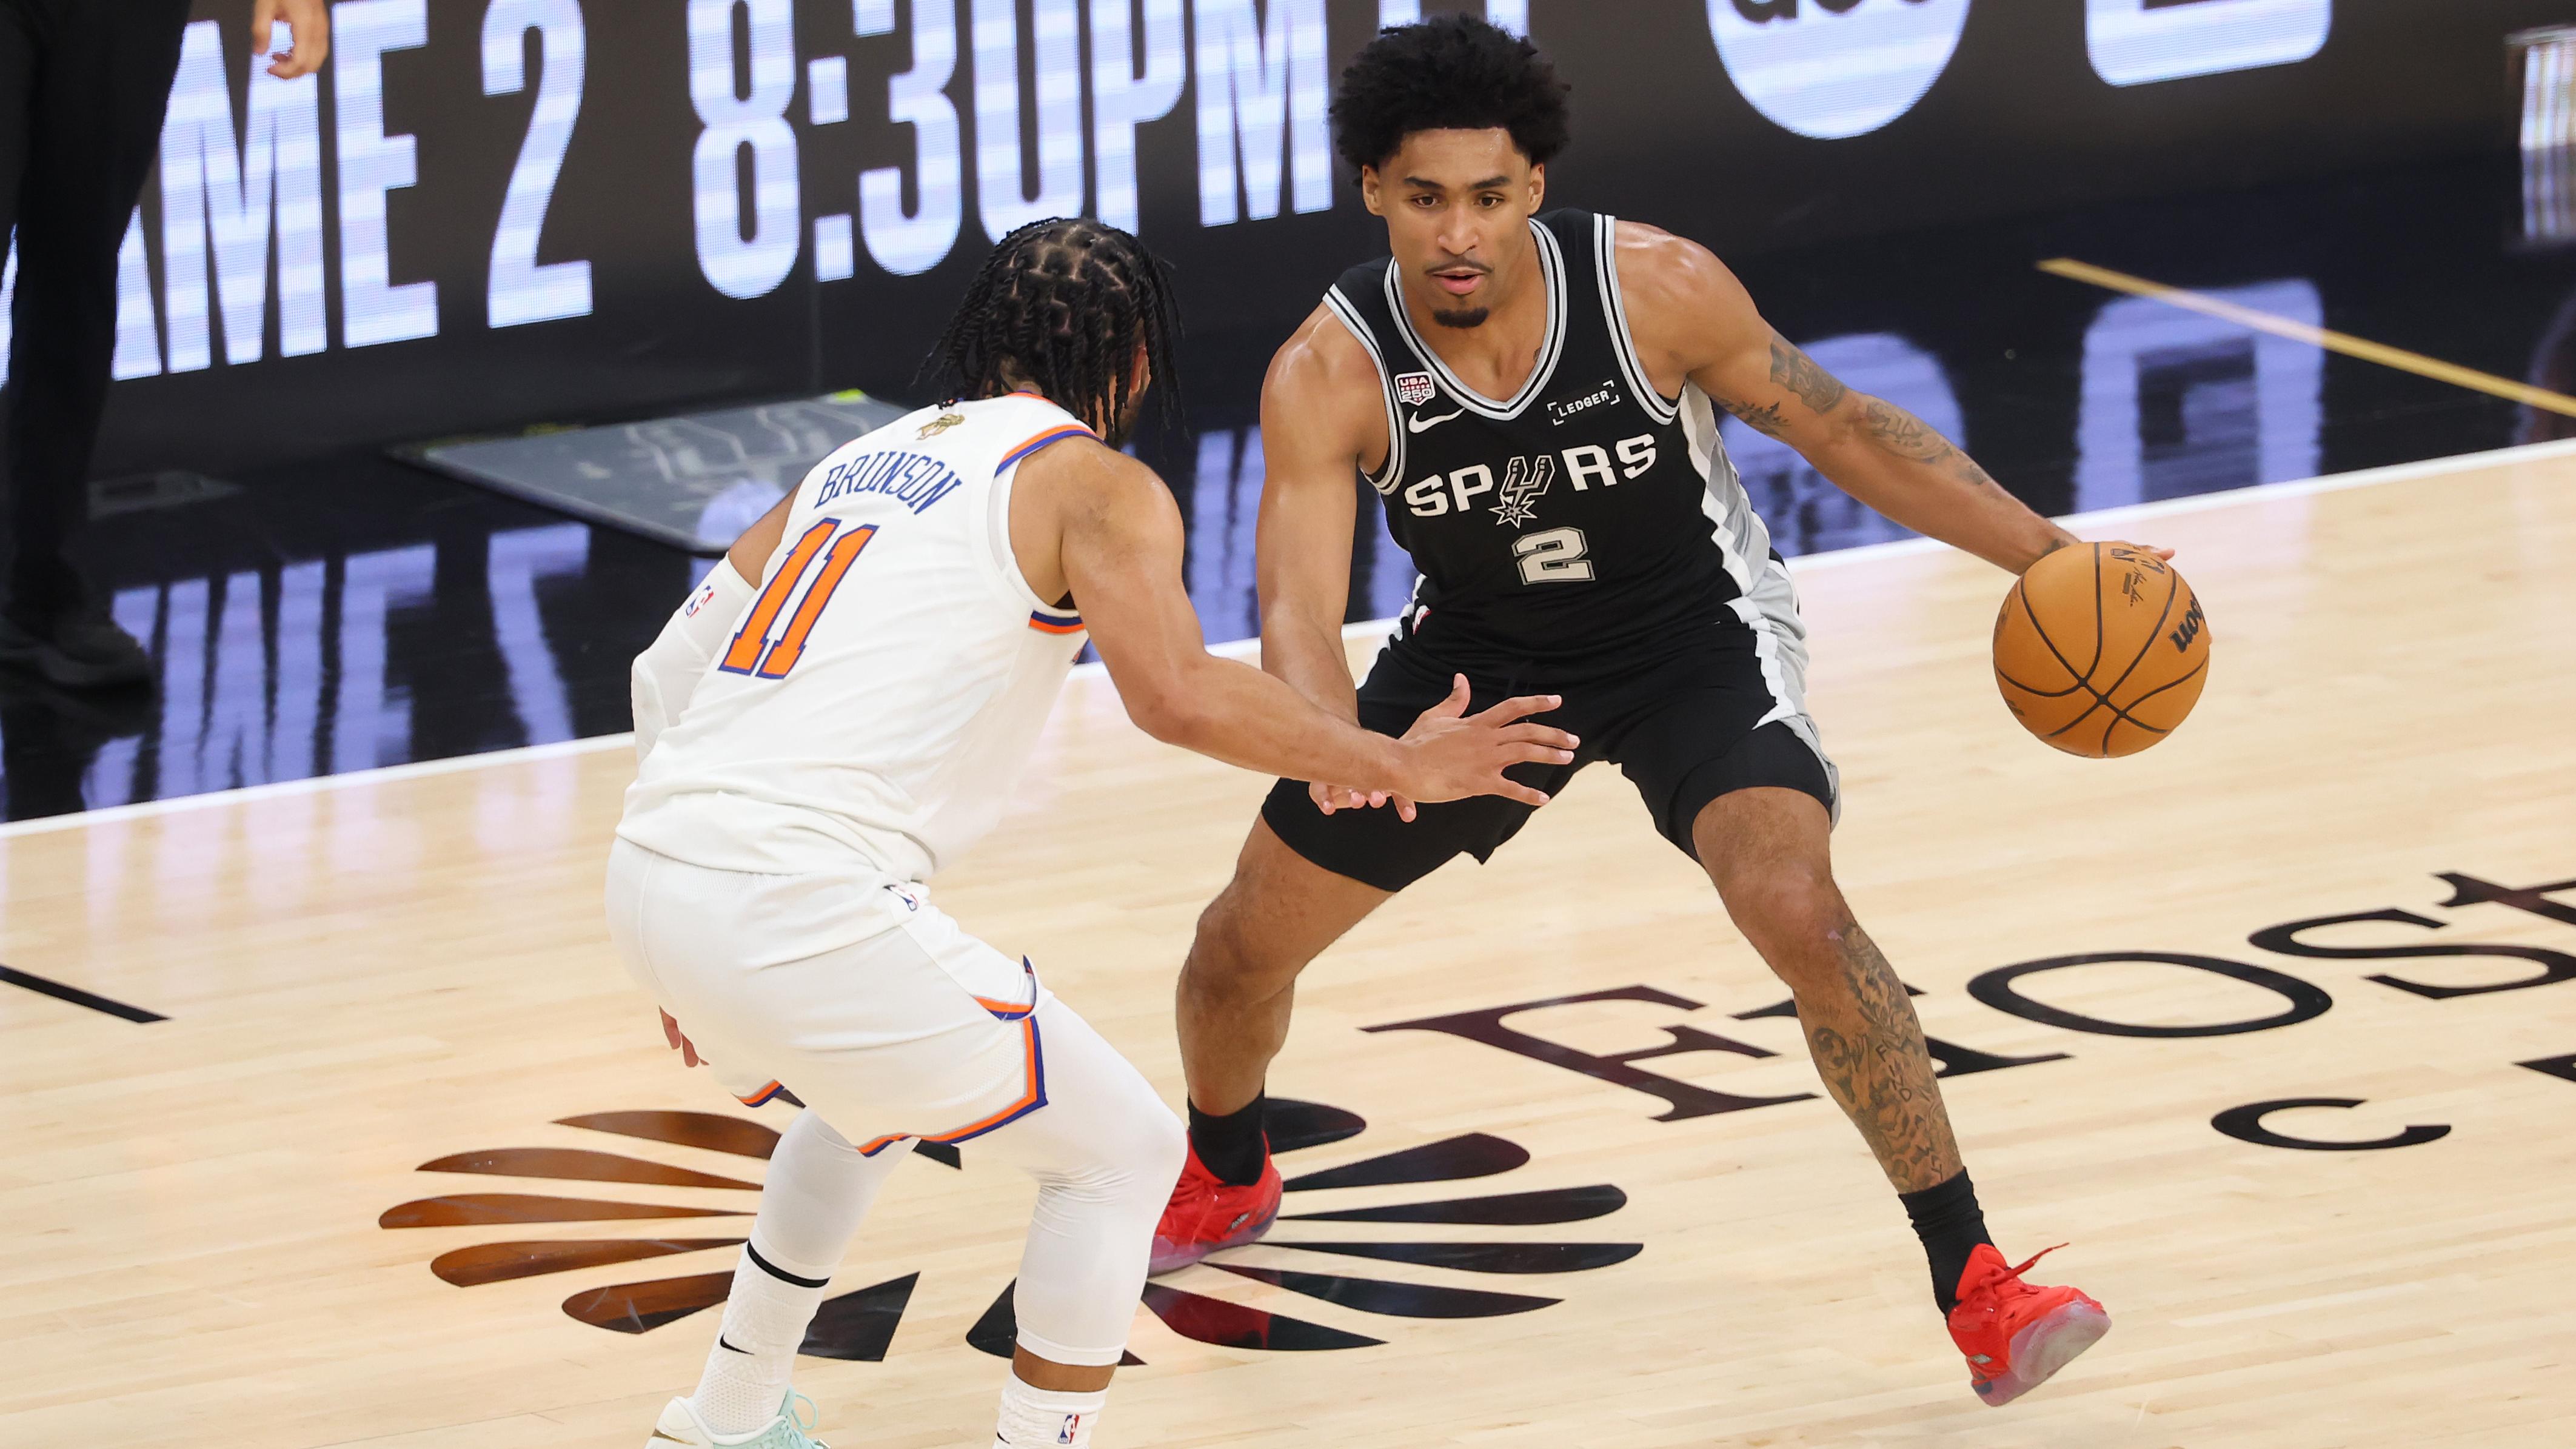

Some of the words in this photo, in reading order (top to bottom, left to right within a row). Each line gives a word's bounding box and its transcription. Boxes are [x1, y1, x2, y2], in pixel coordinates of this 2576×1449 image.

[481, 0, 594, 329] 2
[1400, 376, 1428, 386] USA
[1401, 388, 1432, 400] 250
[1557, 390, 1610, 417] LEDGER
[814, 451, 963, 515] BRUNSON
[1404, 433, 1657, 529] SPURS
[1511, 527, 1596, 585] 2
[718, 517, 880, 680] 11
[1875, 1044, 1912, 1102] FIND
